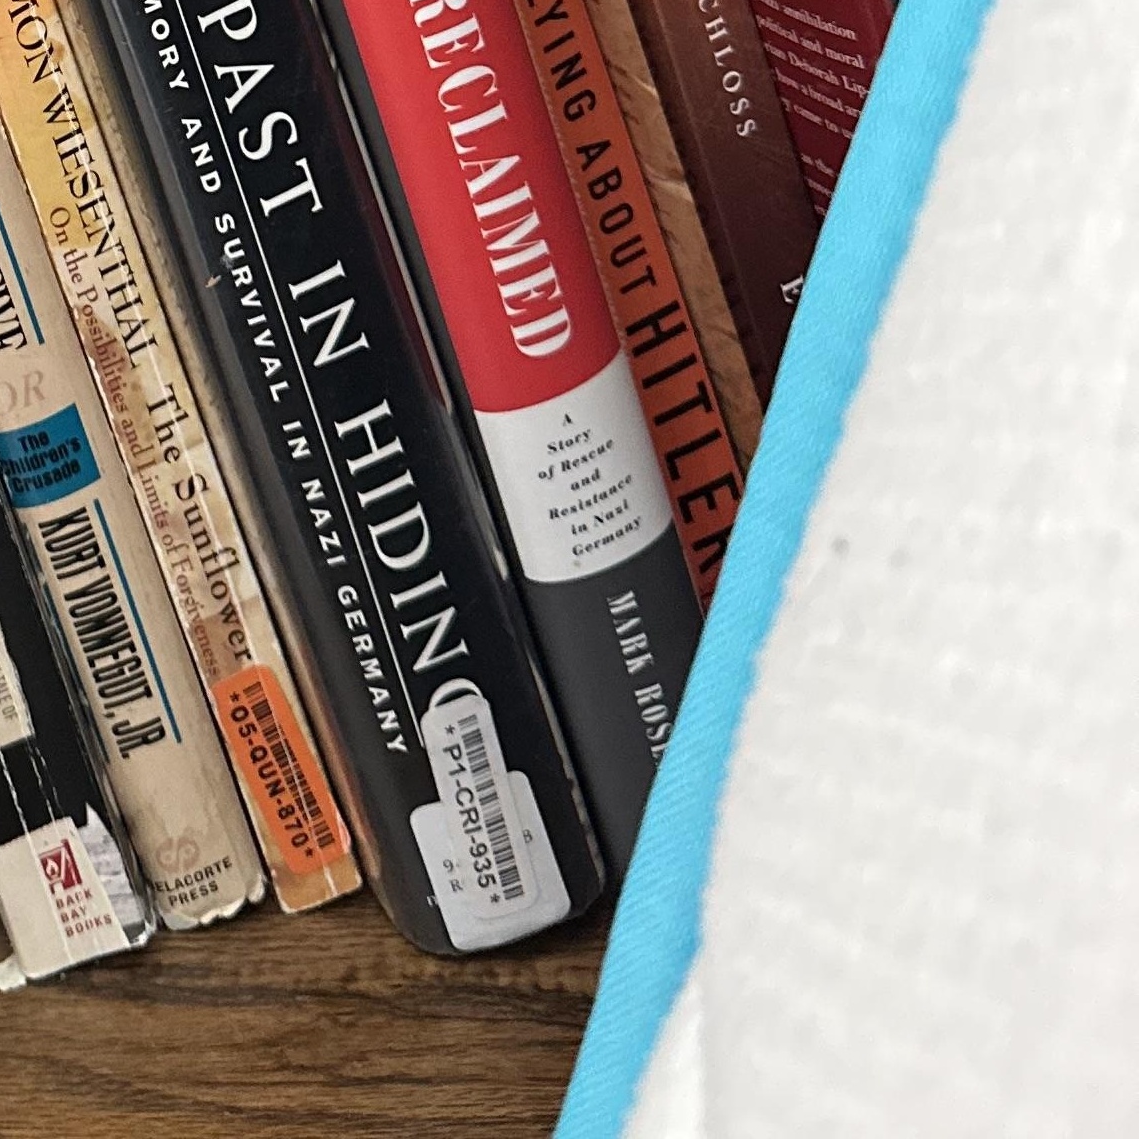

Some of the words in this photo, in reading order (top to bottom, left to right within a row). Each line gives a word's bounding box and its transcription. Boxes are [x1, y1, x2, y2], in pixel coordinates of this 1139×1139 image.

[824, 47, 866, 70] moral
[49, 205, 71, 246] On
[575, 138, 658, 295] ABOUT
[63, 247, 89, 284] the
[288, 260, 369, 371] IN
[76, 283, 129, 413] Possibilities
[42, 86, 162, 371] WIESENTHAL
[146, 383, 190, 464] The
[171, 471, 253, 663] Sunflower
[121, 417, 155, 459] and
[181, 117, 222, 194] AND
[215, 212, 296, 403] SURVIVAL
[282, 420, 311, 460] IN
[301, 478, 346, 568] NAZI
[337, 583, 409, 755] GERMANY
[561, 412, 573, 427] A
[3, 436, 82, 480] Children's
[17, 429, 51, 452] The
[537, 461, 557, 482] of
[559, 436, 615, 474] Rescue
[547, 427, 594, 456] Story
[9, 459, 81, 496] Crusade
[137, 458, 170, 530] Limits
[548, 472, 634, 523] Resistance
[569, 467, 602, 492] and
[570, 518, 591, 537] in
[593, 497, 631, 527] Nazi
[571, 515, 643, 560] Germany
[162, 531, 190, 556] of
[38, 506, 106, 581] KURT
[112, 716, 166, 760] JR.
[170, 553, 220, 678] Forgiveness
[606, 590, 655, 676] MARK
[1, 705, 20, 725] OF
[442, 742, 499, 889] P1-CRI-935
[55, 889, 93, 909] BACK
[168, 880, 221, 908] PRESS
[60, 906, 88, 925] BAY
[64, 914, 114, 939] BOOKS
